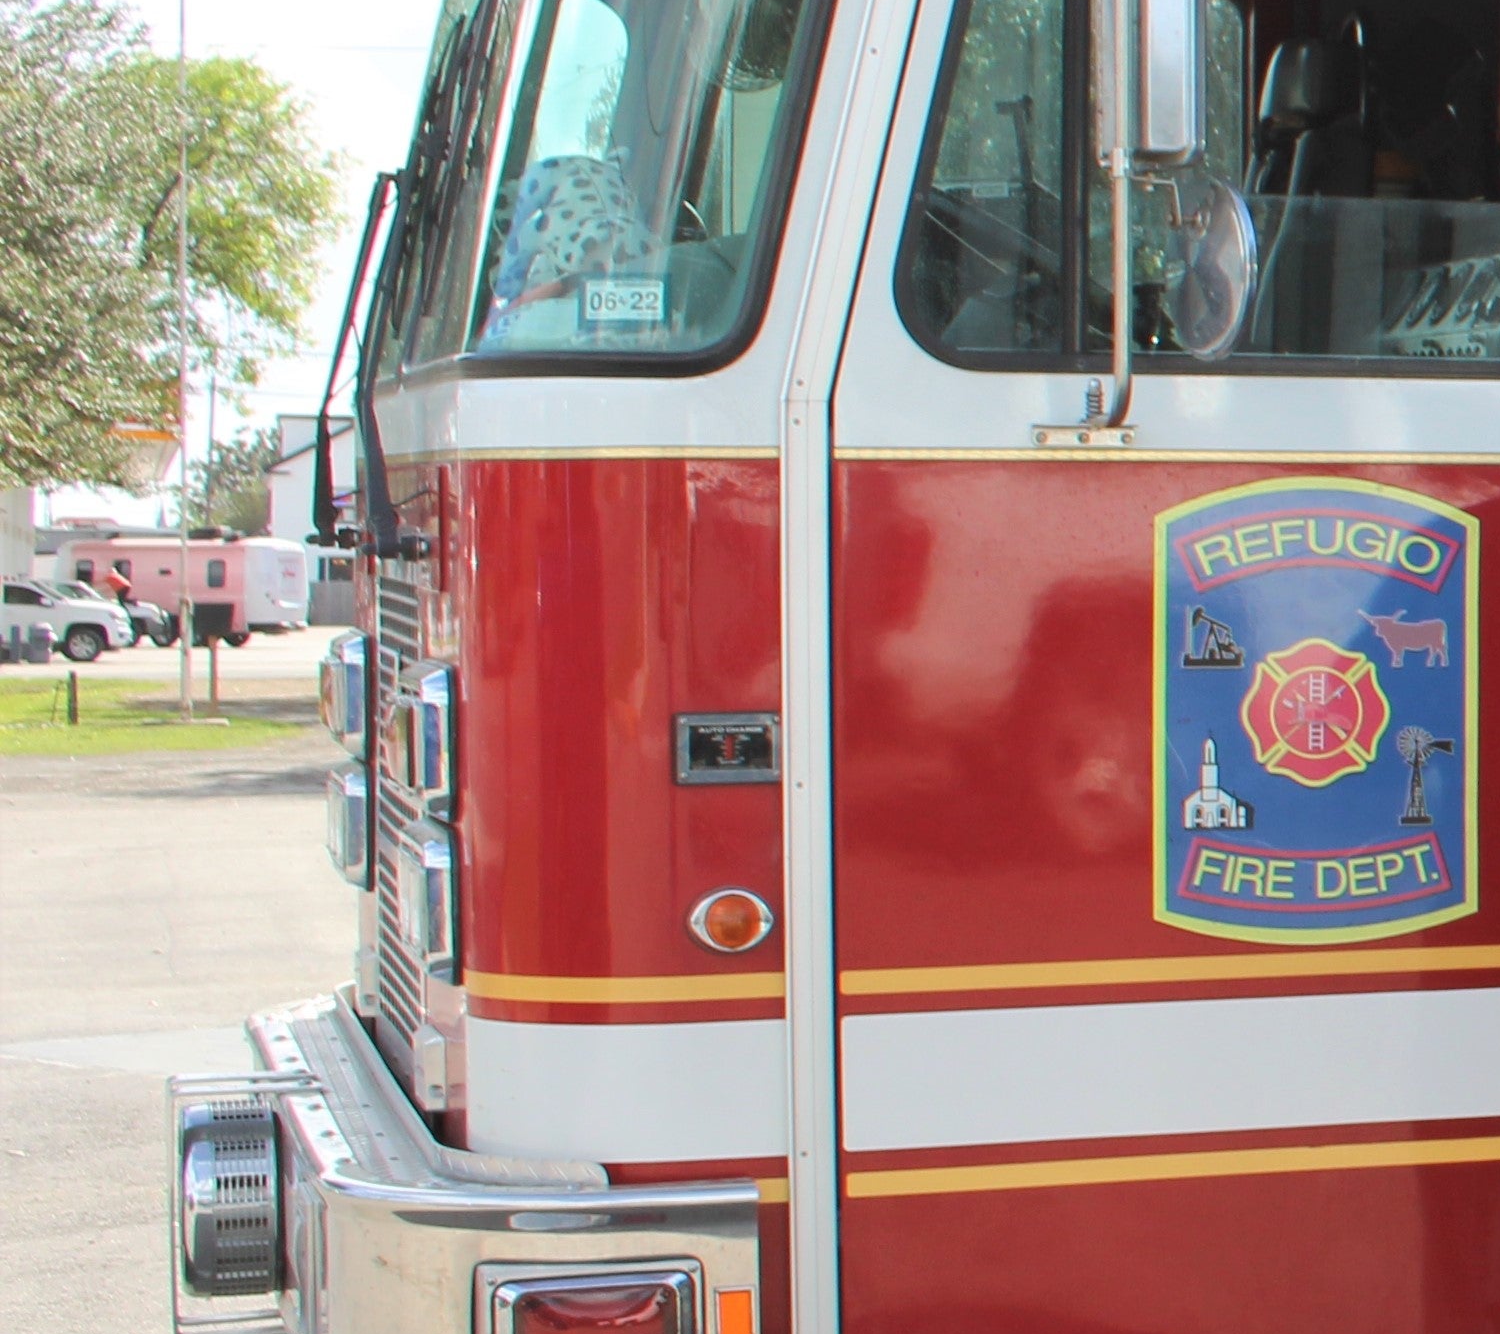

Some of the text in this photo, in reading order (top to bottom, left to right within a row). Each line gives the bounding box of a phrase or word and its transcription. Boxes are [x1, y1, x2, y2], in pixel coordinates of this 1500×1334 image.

[590, 291, 659, 311] 06 22
[1193, 519, 1442, 576] REFUGIO
[1193, 844, 1440, 899] FIRE DEPT.
